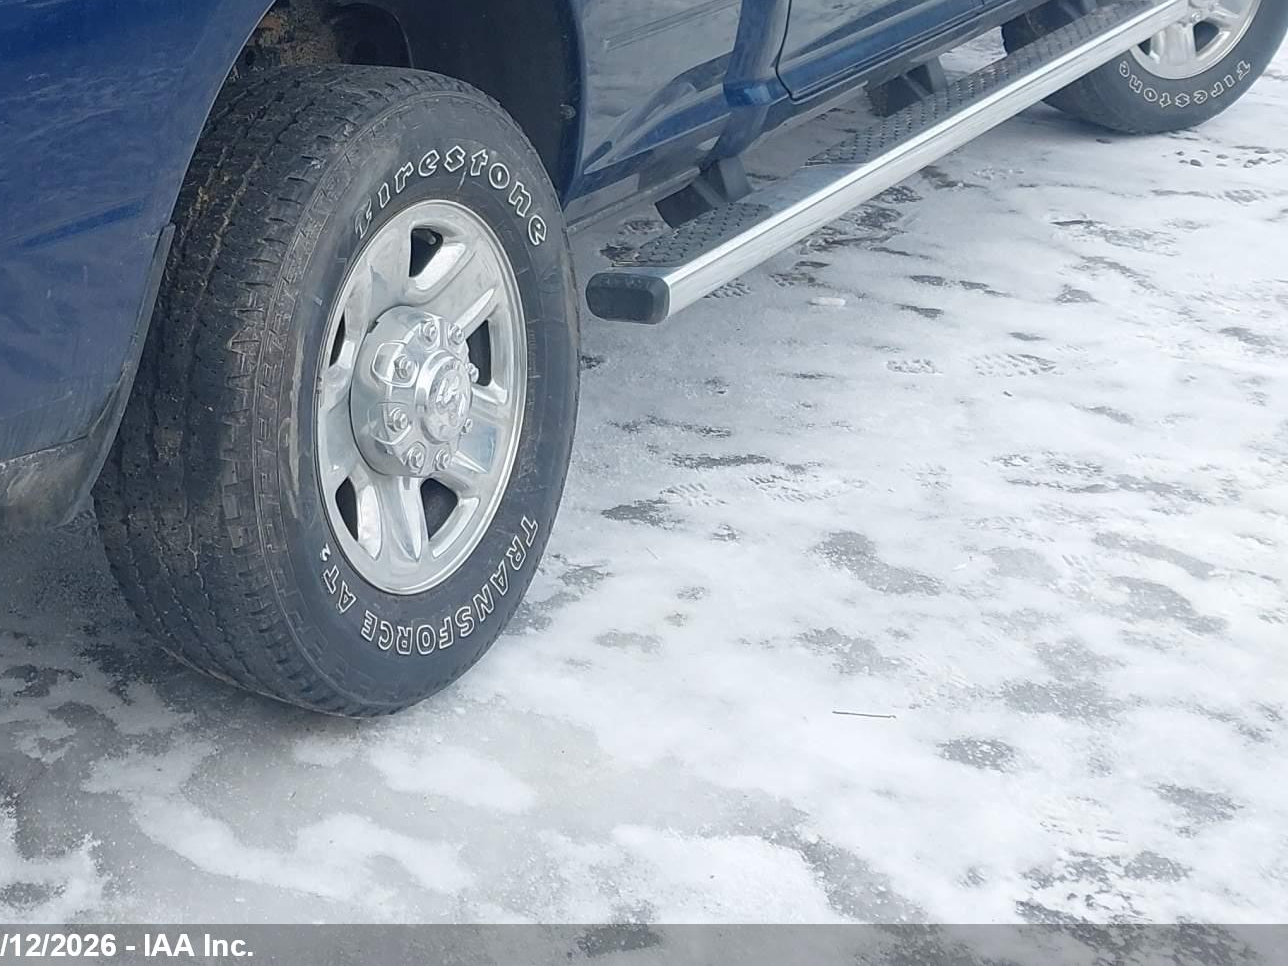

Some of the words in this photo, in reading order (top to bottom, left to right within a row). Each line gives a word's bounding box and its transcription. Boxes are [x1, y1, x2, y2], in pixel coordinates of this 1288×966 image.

[1119, 60, 1251, 108] Firestone
[354, 145, 547, 246] Firestone
[361, 515, 538, 655] TRANSFORCE
